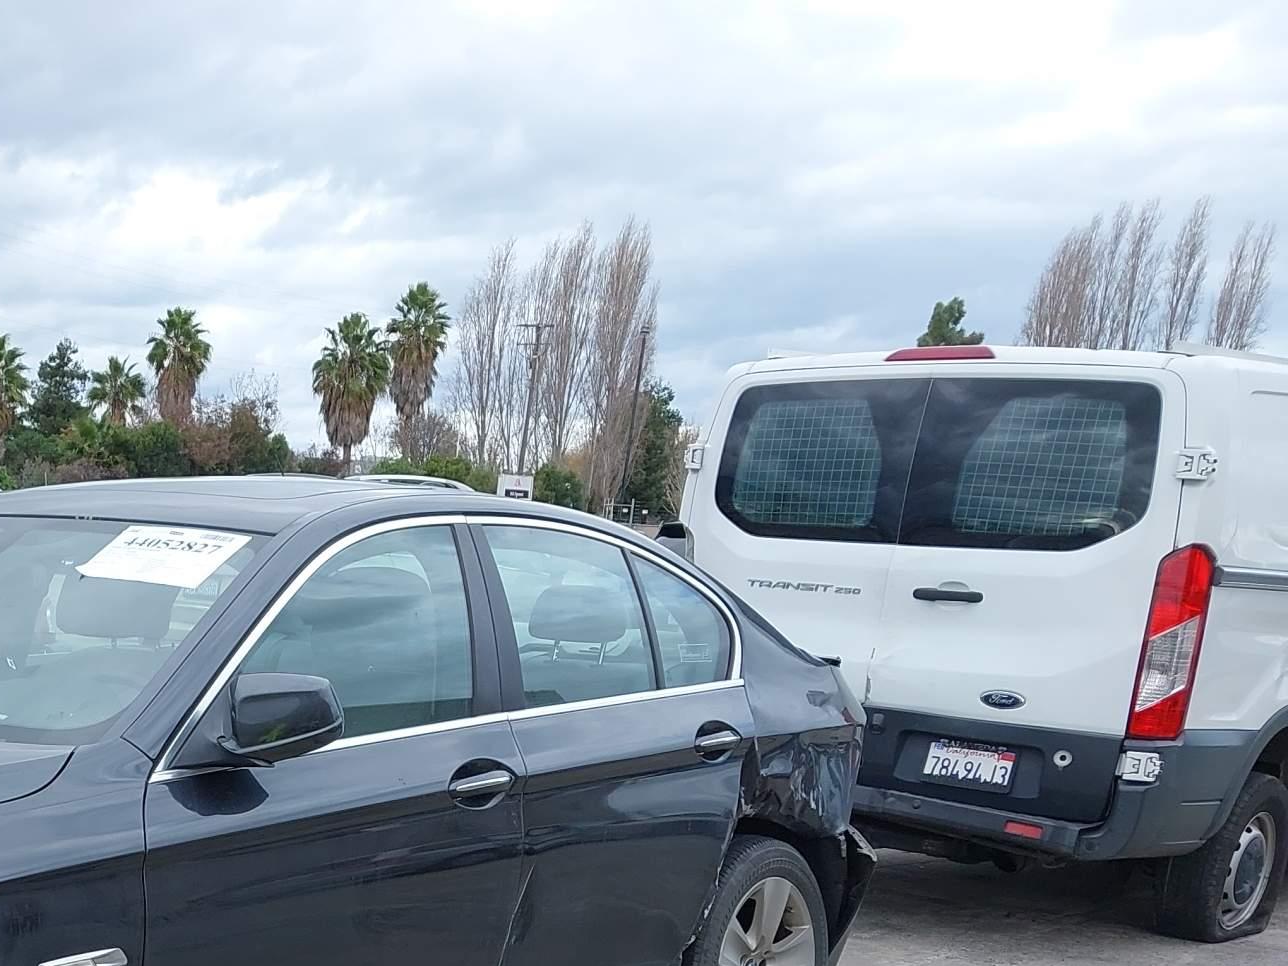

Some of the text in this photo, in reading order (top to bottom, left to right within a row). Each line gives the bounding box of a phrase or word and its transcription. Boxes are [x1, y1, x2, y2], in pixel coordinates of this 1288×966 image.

[124, 536, 224, 555] 44052827
[747, 578, 861, 595] TRANSIT 250
